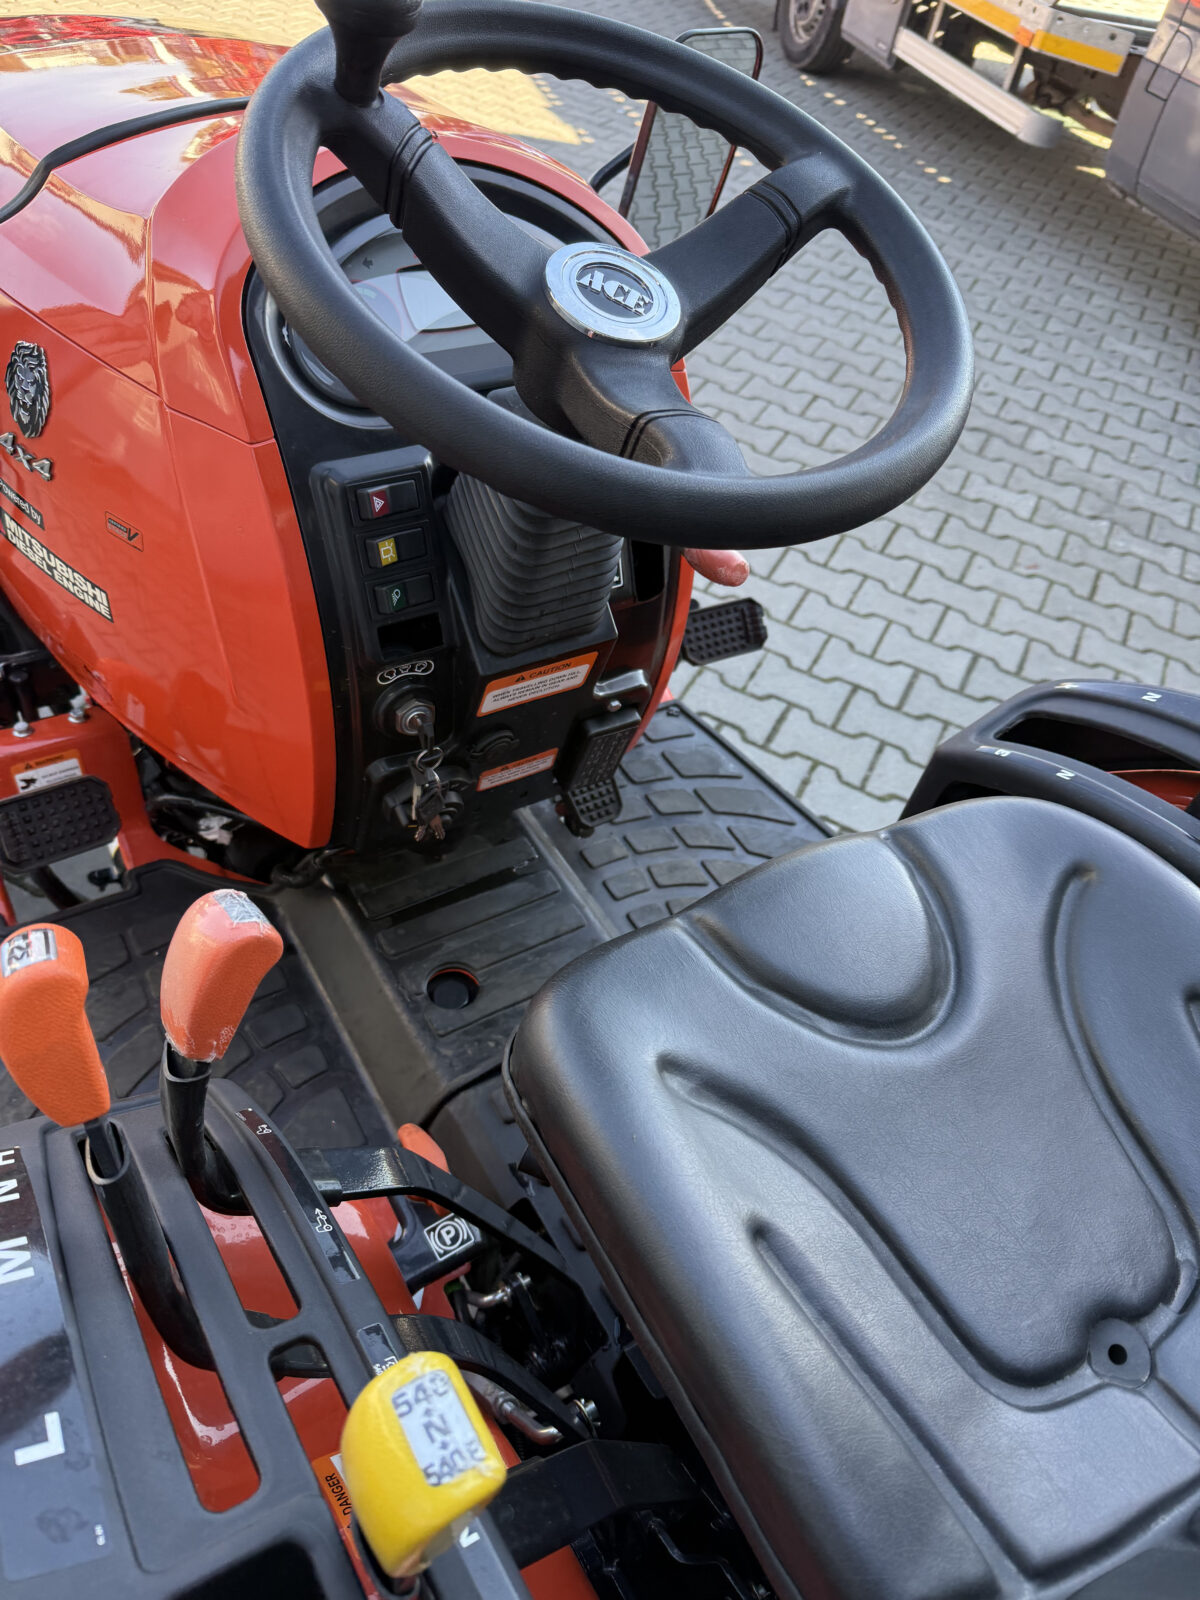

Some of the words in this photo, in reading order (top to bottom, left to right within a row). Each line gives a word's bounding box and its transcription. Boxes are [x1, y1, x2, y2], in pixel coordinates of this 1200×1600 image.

[576, 270, 653, 316] ACE
[4, 513, 109, 608] MITSUBISHI
[7, 529, 53, 576] DIESEL
[53, 568, 112, 620] ENGINE
[529, 662, 572, 679] CAUTION
[444, 1225, 457, 1245] P
[14, 1411, 65, 1466] L
[423, 1414, 452, 1444] N
